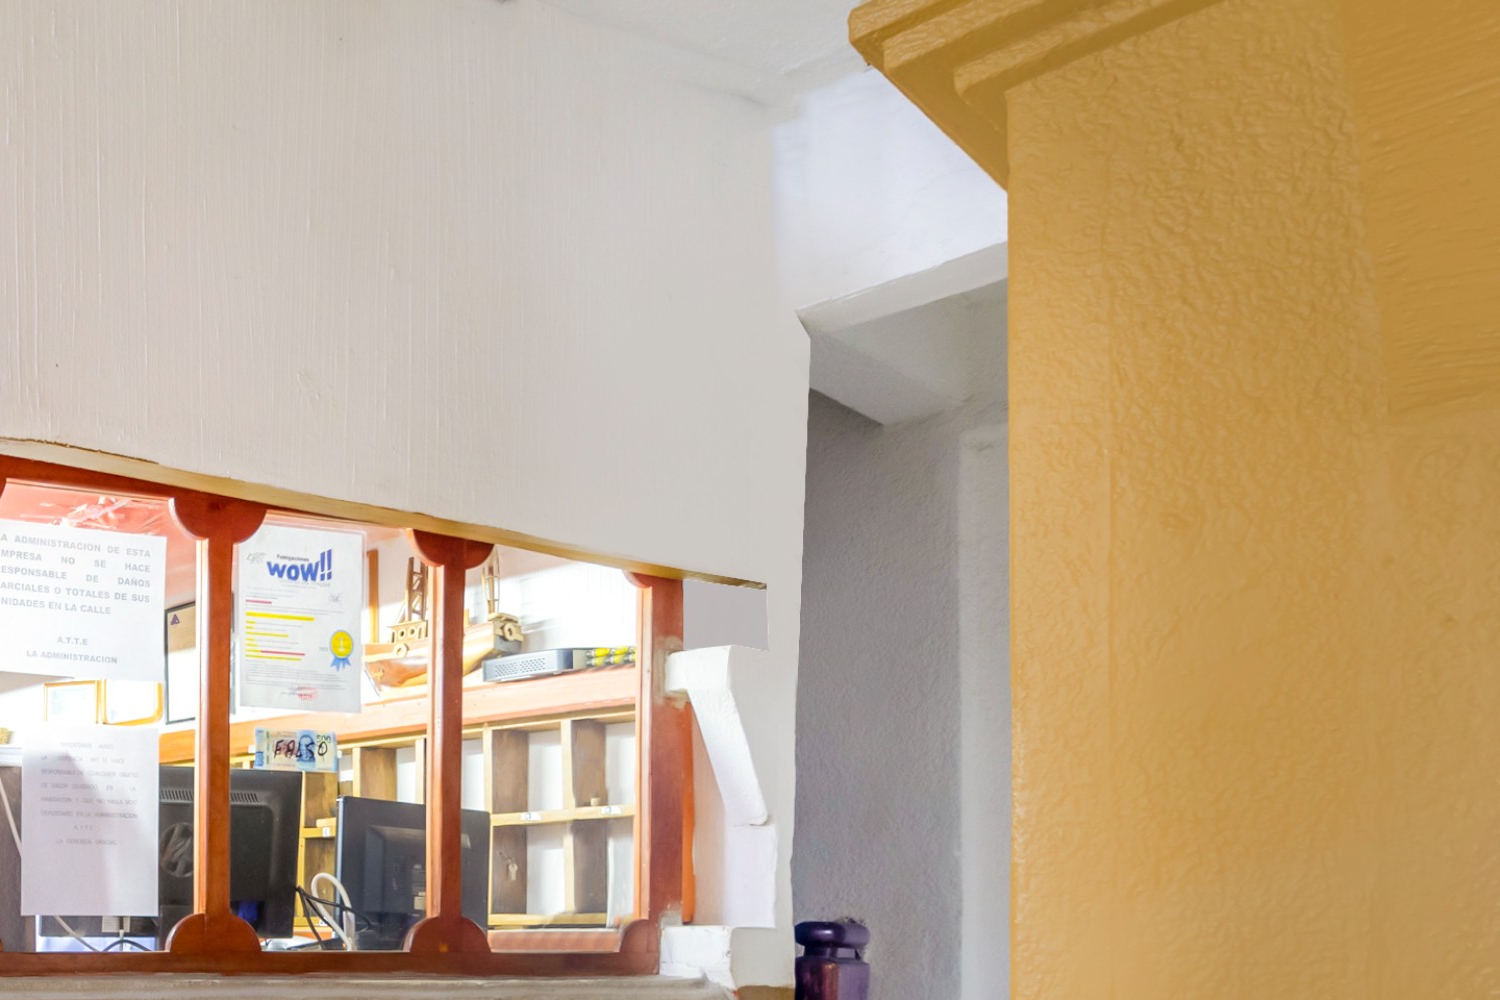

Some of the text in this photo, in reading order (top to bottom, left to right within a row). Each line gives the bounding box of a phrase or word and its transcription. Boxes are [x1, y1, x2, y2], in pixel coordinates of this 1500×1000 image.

[14, 536, 101, 552] ADMINISTRACION
[107, 546, 120, 555] DE
[126, 548, 151, 558] ESTA
[61, 556, 75, 565] NO
[94, 560, 106, 568] SE
[125, 563, 151, 573] HACE
[86, 575, 99, 583] DE
[118, 576, 150, 588] DAÑOS
[66, 588, 109, 599] TOTALES
[114, 593, 127, 601] DE
[131, 594, 150, 603] SUS
[48, 602, 61, 610] EN
[65, 603, 77, 611] LA
[80, 605, 111, 615] CALLE
[27, 650, 117, 664] LA ADMINISTRACION
